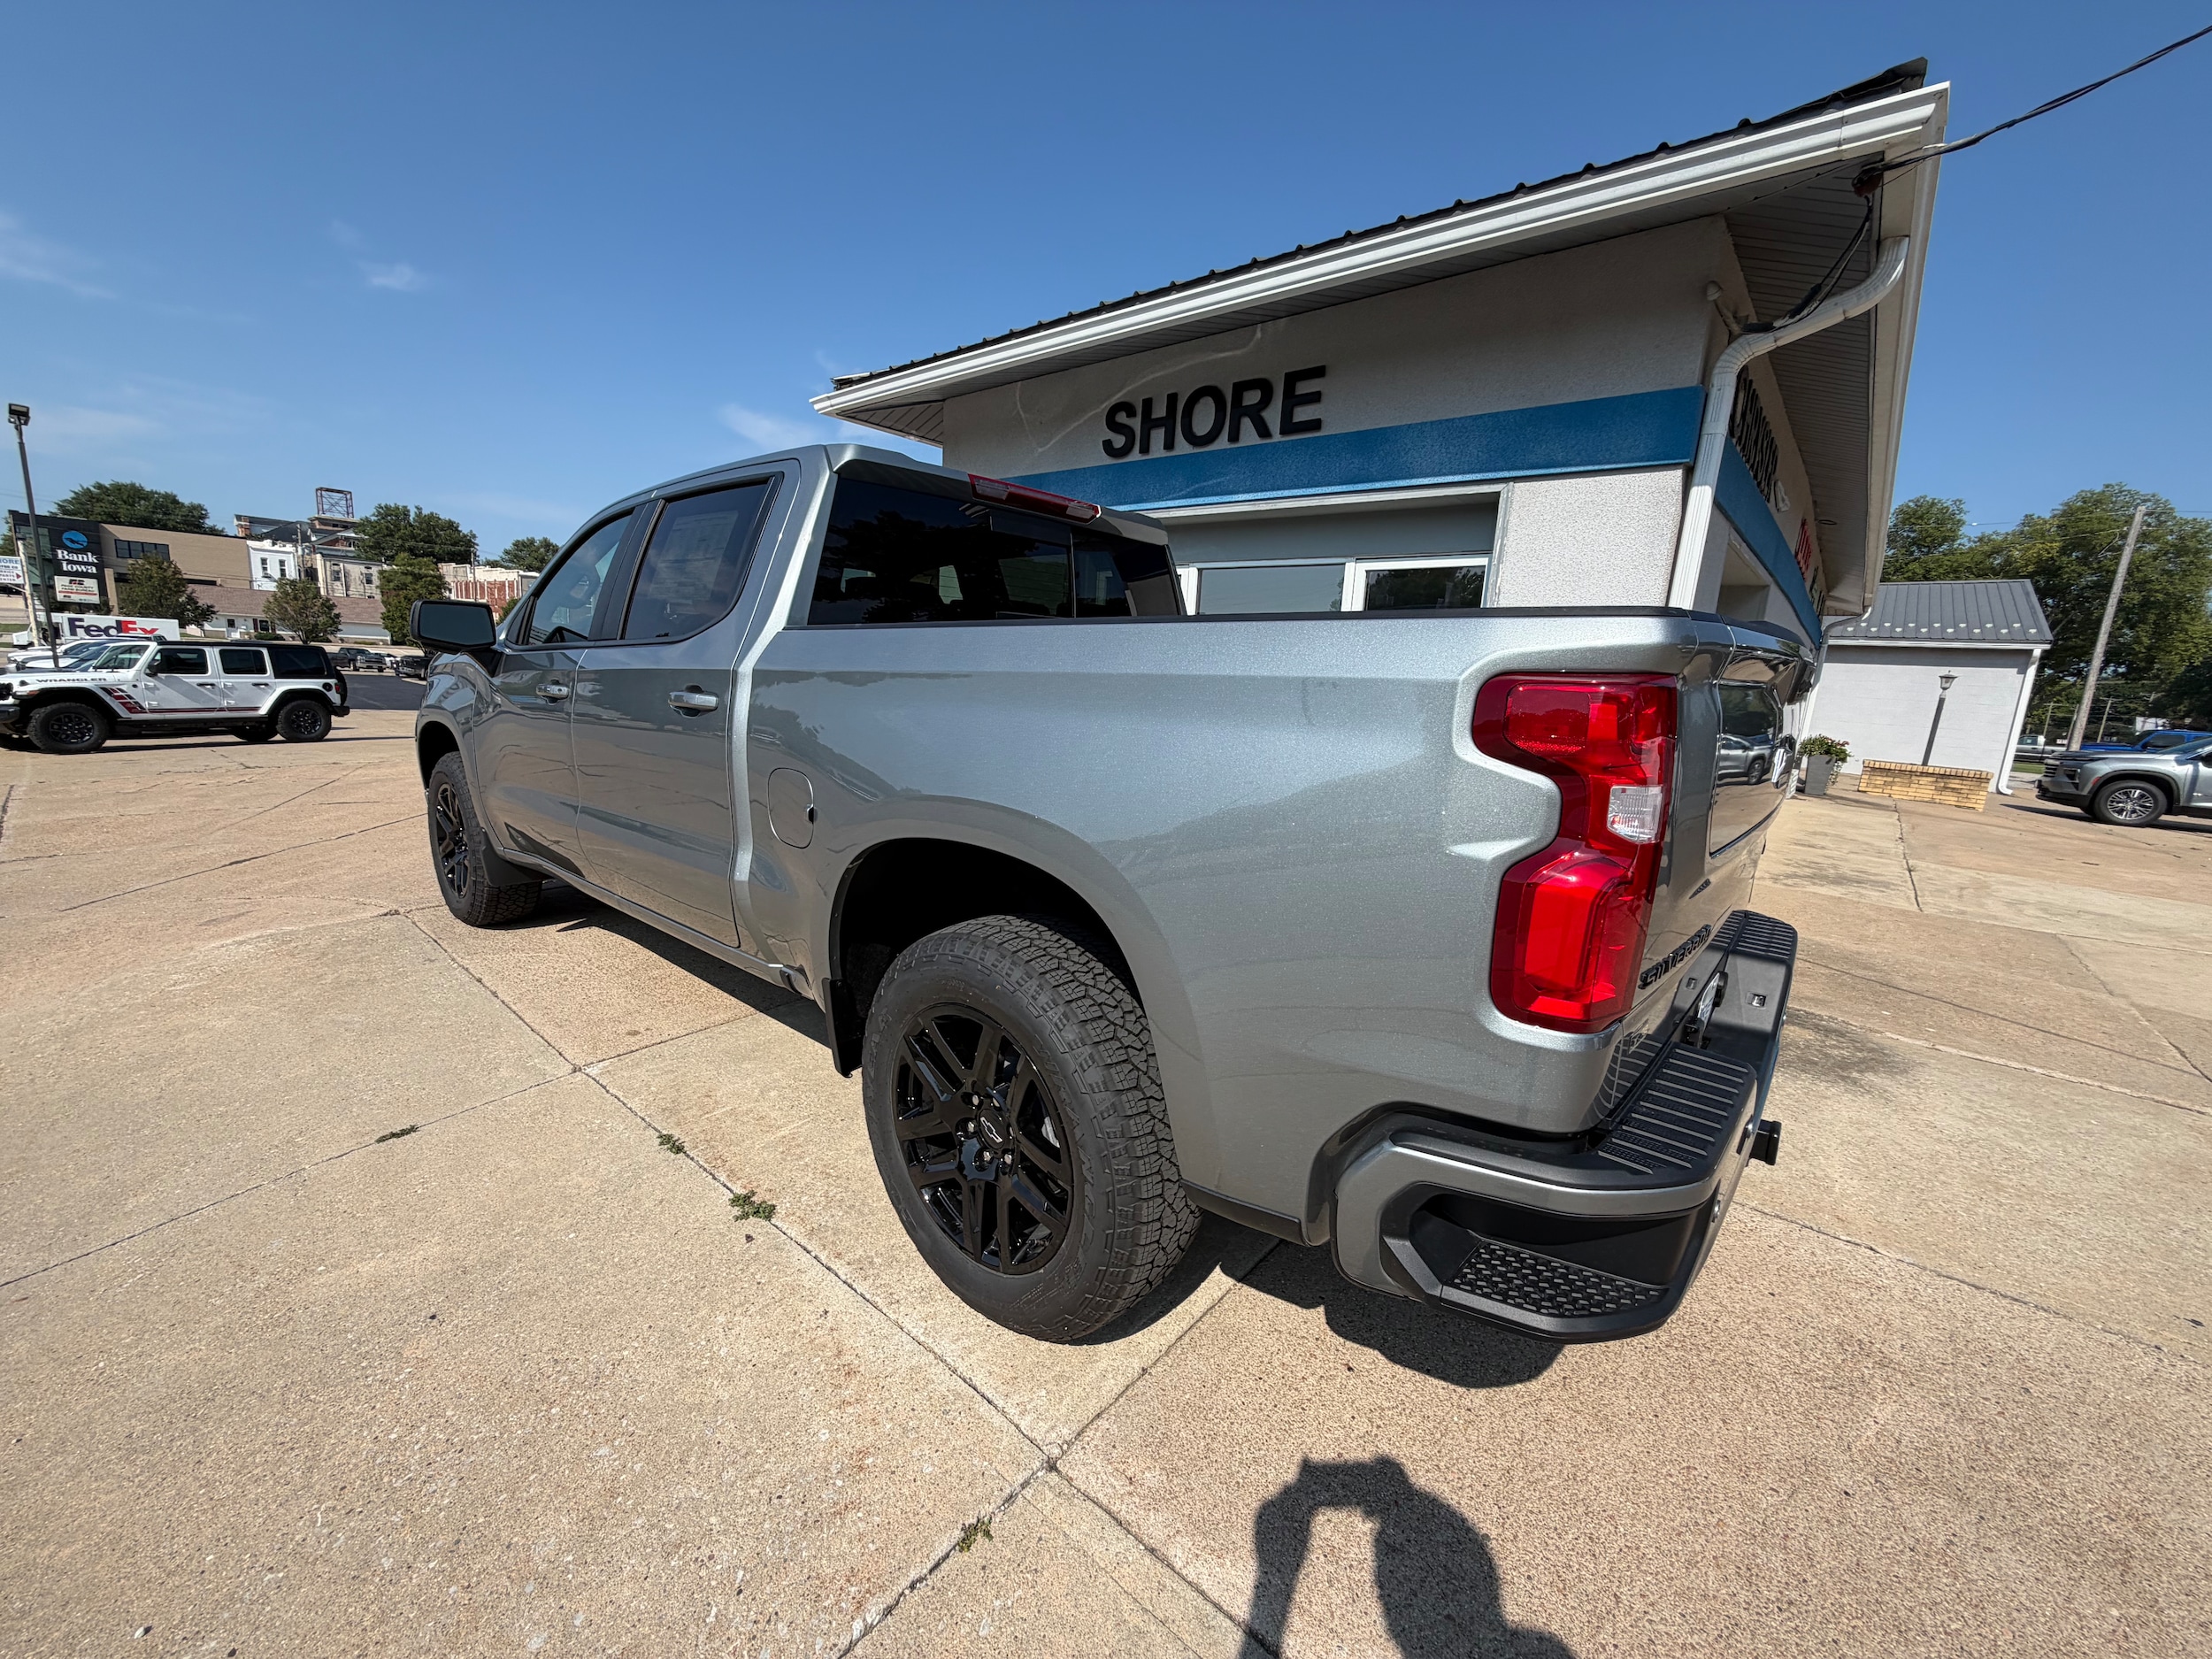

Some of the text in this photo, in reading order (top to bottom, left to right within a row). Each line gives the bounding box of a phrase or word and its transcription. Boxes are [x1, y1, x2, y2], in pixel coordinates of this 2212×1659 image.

[1102, 365, 1326, 459] SHORE
[56, 549, 99, 563] Bank
[60, 561, 97, 574] Iowa
